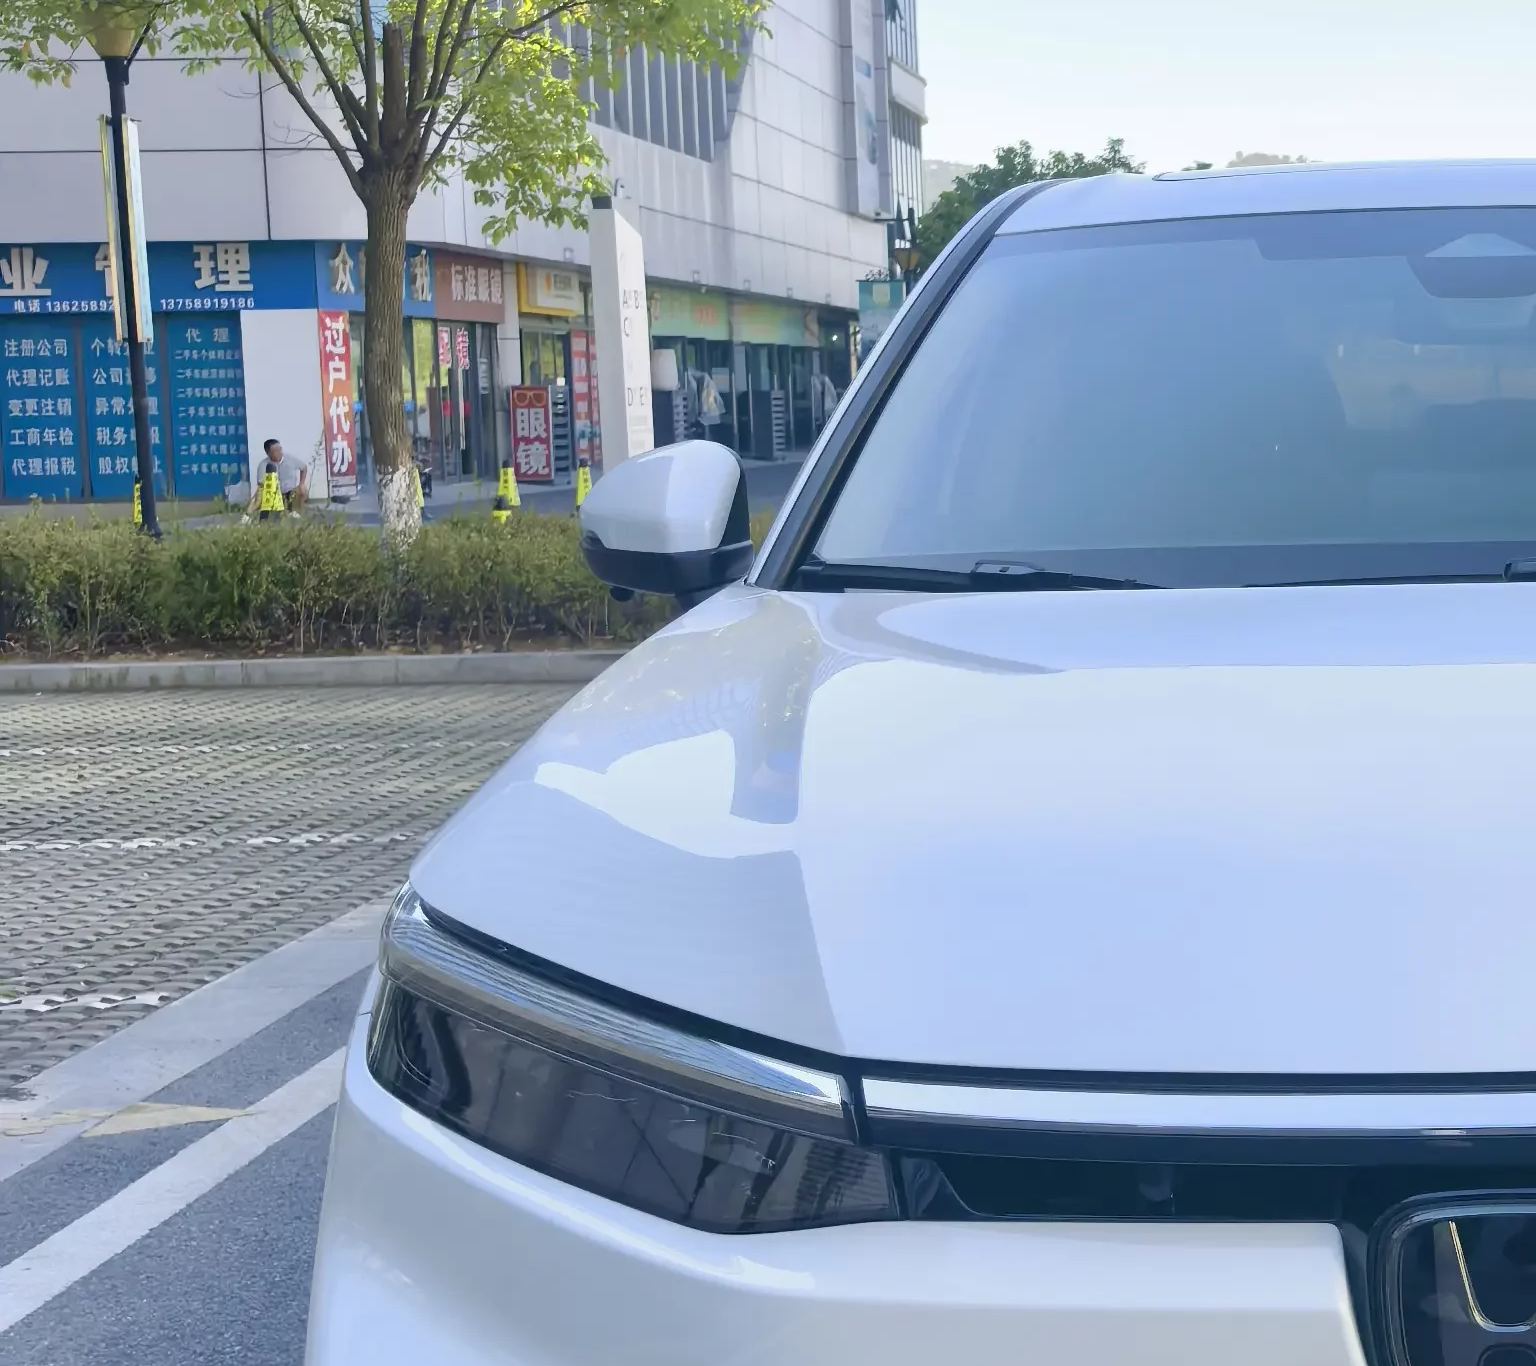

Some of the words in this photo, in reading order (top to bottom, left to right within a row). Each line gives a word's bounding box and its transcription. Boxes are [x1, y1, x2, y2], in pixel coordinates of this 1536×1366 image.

[451, 263, 503, 304] 标准眼镜
[14, 299, 40, 313] 电话
[186, 327, 230, 343] 代理
[4, 338, 67, 357] 注册公司
[7, 368, 70, 387] 代理记账
[324, 316, 352, 473] 过户代办
[8, 398, 72, 417] 变更注销
[10, 427, 74, 446] 工商年检
[515, 408, 549, 475] 眼镜
[12, 457, 76, 476] 代理报税
